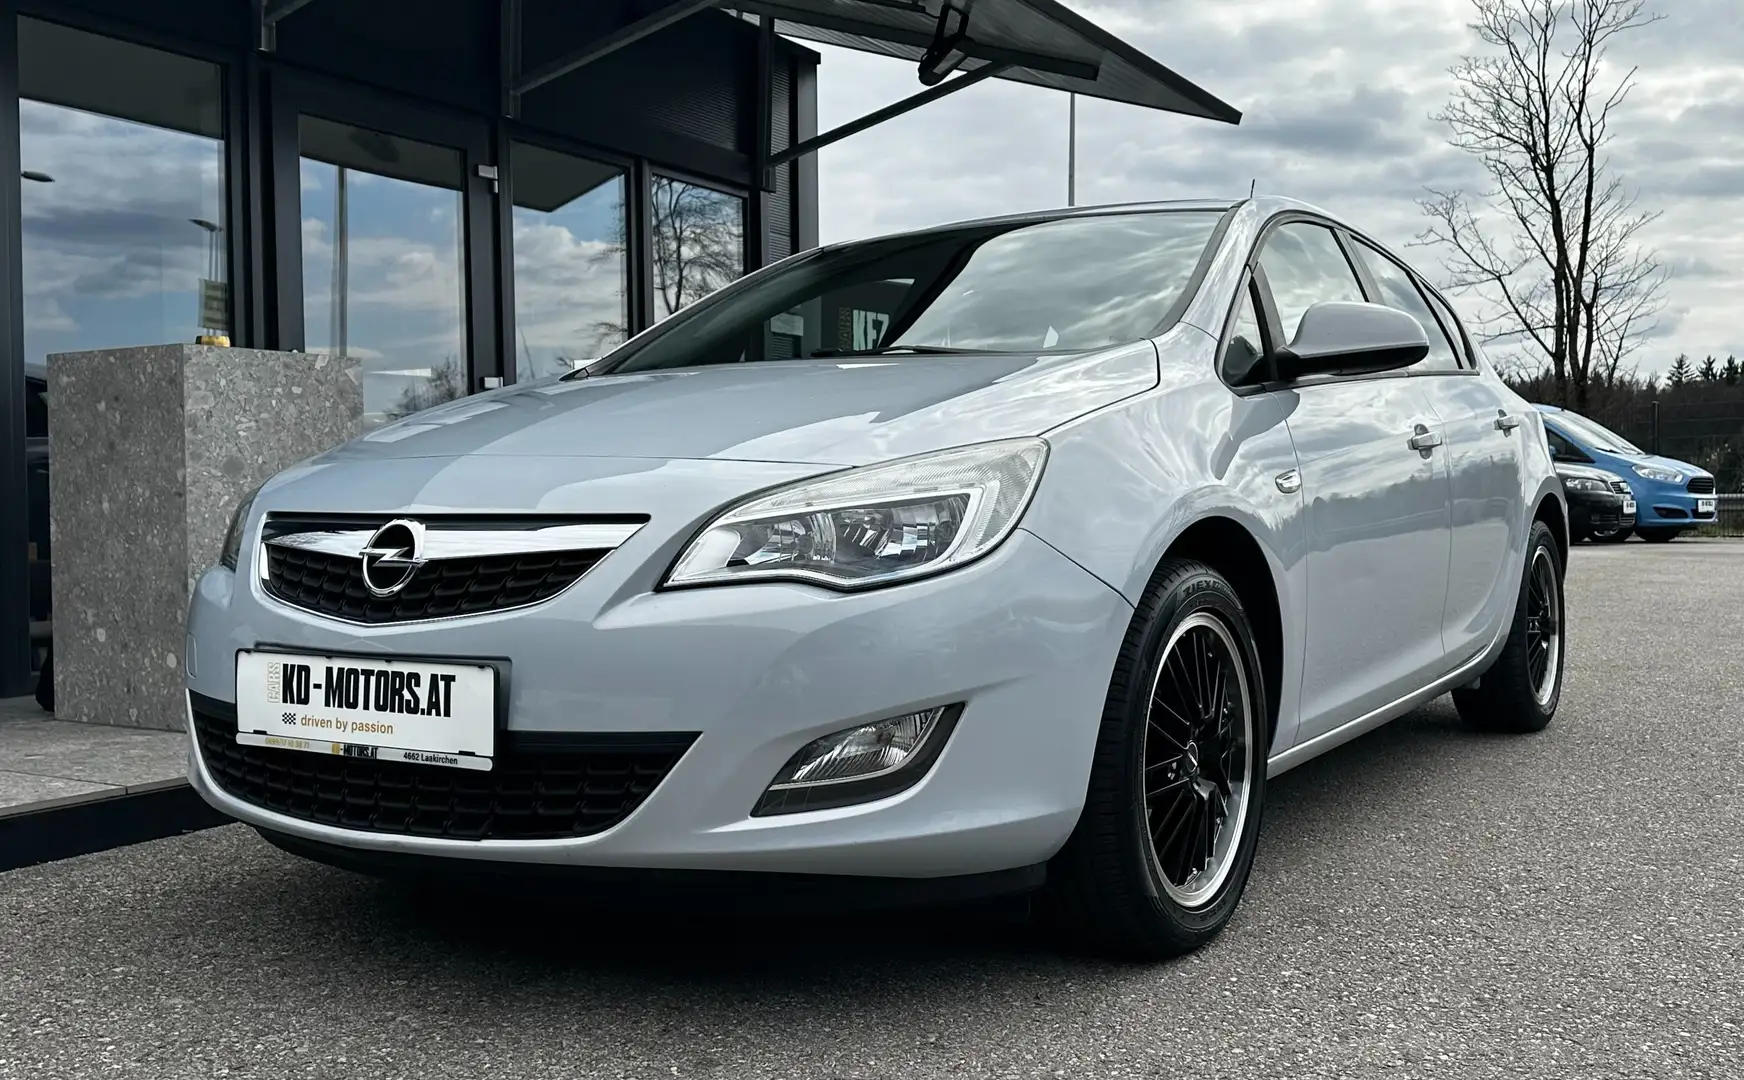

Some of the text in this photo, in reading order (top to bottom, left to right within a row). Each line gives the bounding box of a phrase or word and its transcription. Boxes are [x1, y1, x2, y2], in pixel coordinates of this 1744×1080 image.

[267, 661, 281, 704] CARS
[281, 663, 456, 718] KD-MOTORS.AT
[300, 714, 394, 735] driven by passion
[403, 751, 458, 765] 4662 Laakirchen
